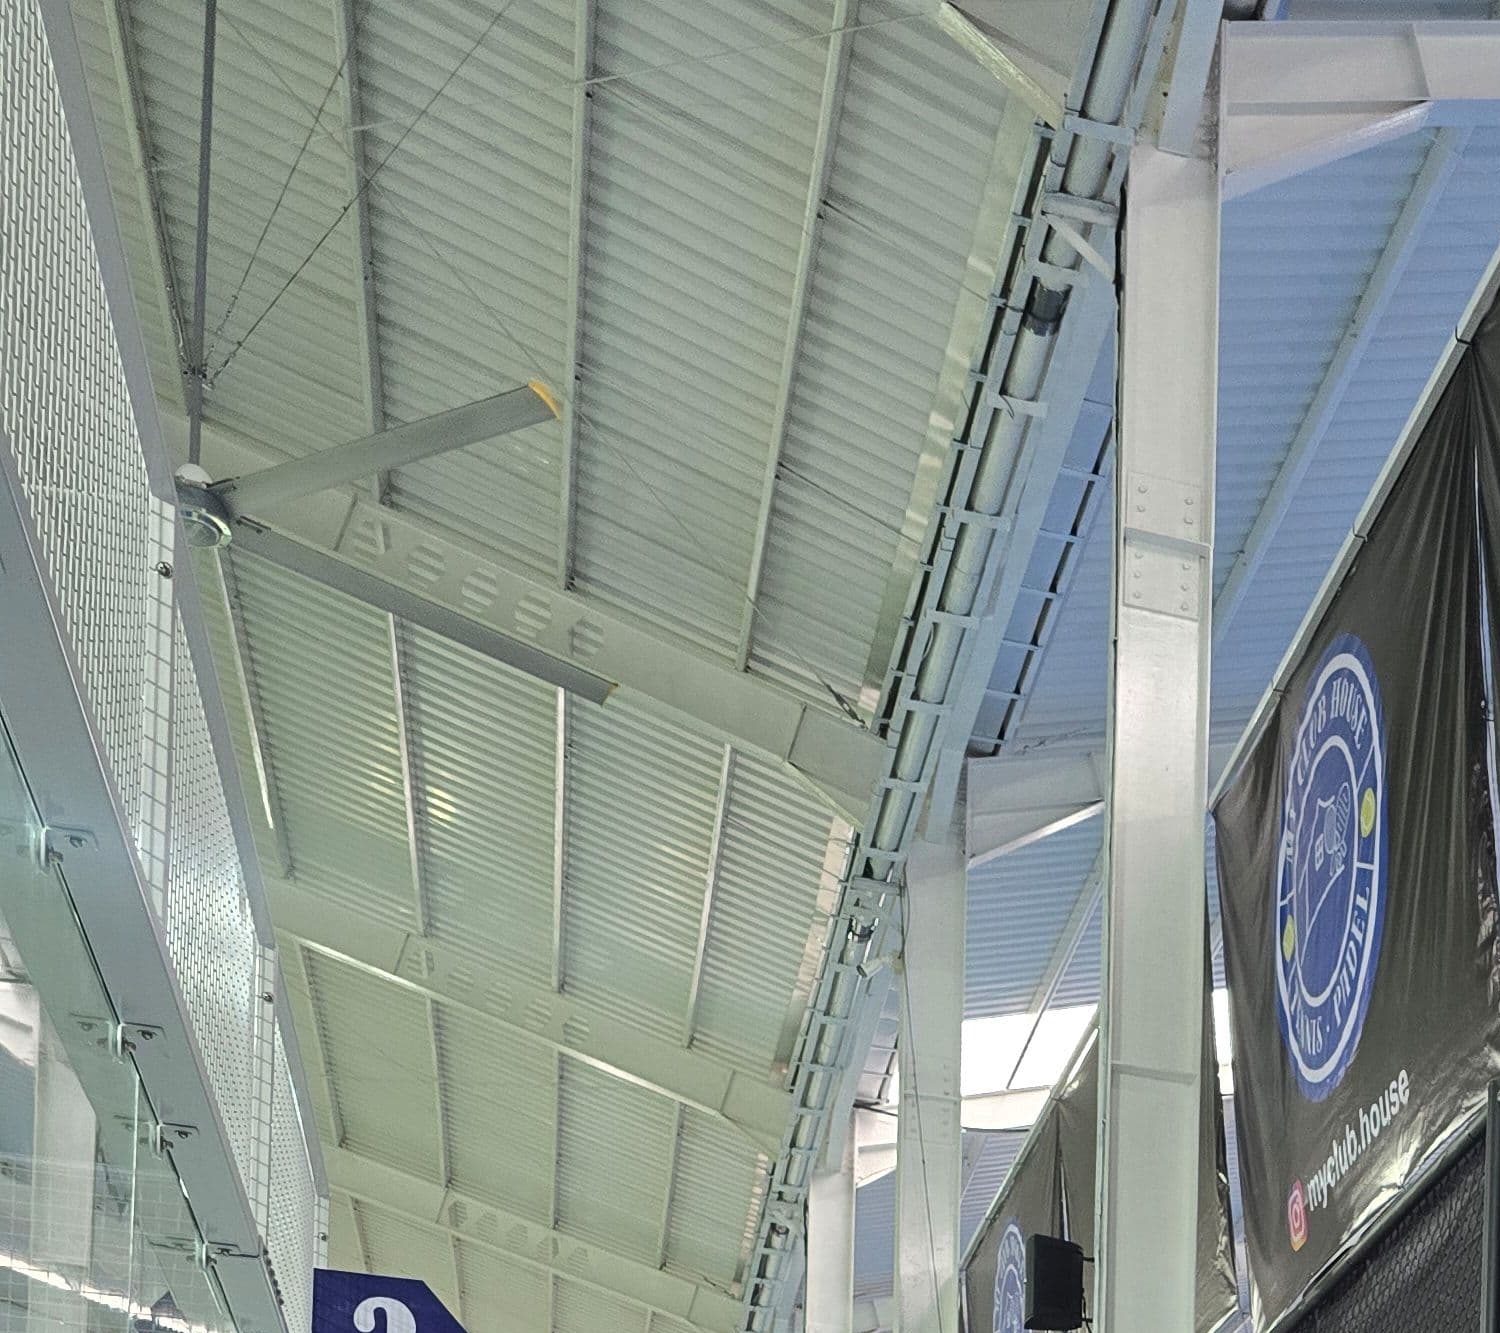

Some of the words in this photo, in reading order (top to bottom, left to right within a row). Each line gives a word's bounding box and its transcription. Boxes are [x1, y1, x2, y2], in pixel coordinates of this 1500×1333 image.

[1297, 694, 1327, 787] CLUB
[1330, 676, 1368, 750] HOUSE
[1333, 886, 1371, 1027] PADEL
[1306, 1068, 1410, 1213] myclub.house
